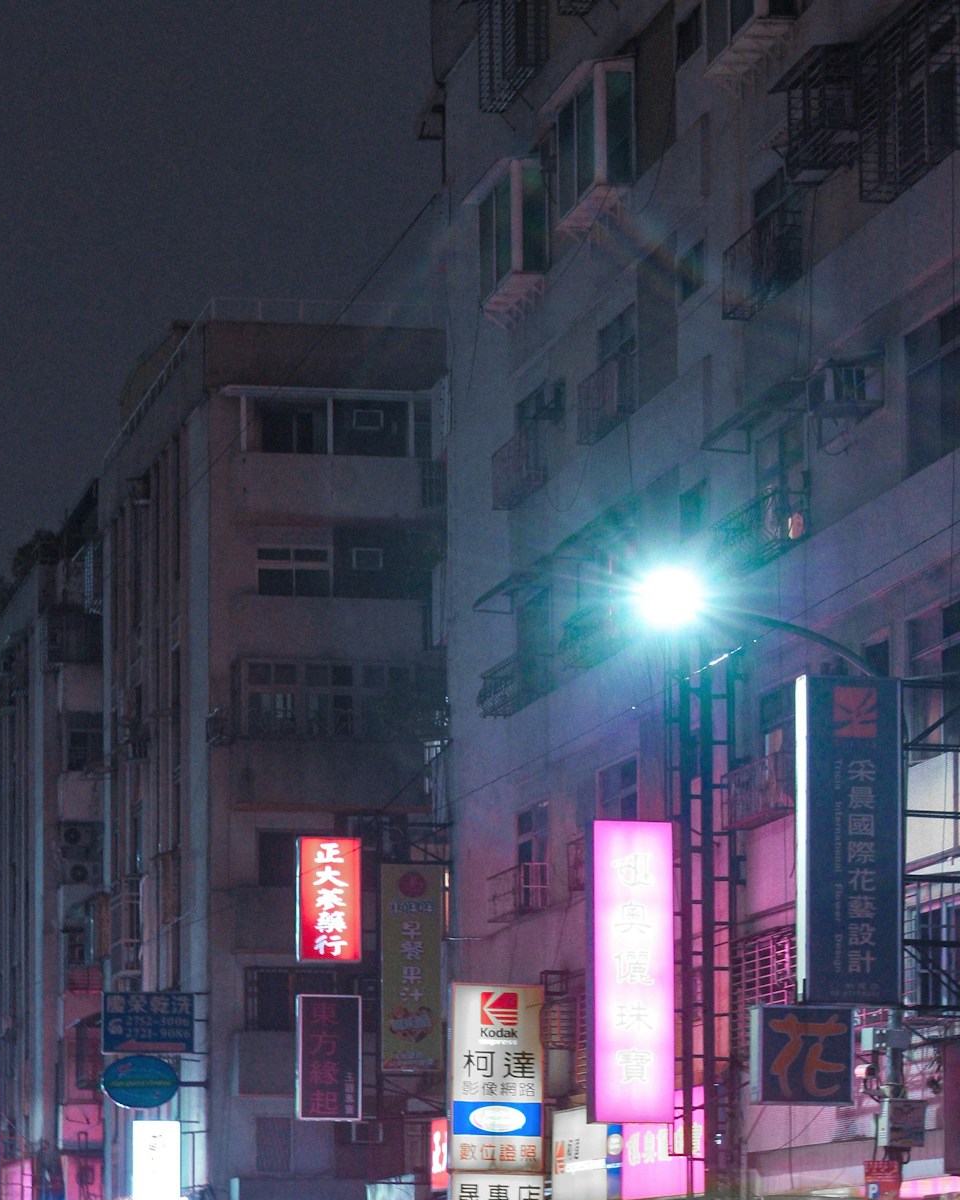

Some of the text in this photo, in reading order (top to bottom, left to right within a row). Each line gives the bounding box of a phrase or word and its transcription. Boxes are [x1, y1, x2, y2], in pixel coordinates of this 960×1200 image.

[480, 1027, 518, 1038] Kodak
[463, 1050, 536, 1079] 柯達
[768, 1013, 847, 1097] 花
[462, 1081, 536, 1097] 影像網路
[460, 1143, 537, 1162] 數位證照
